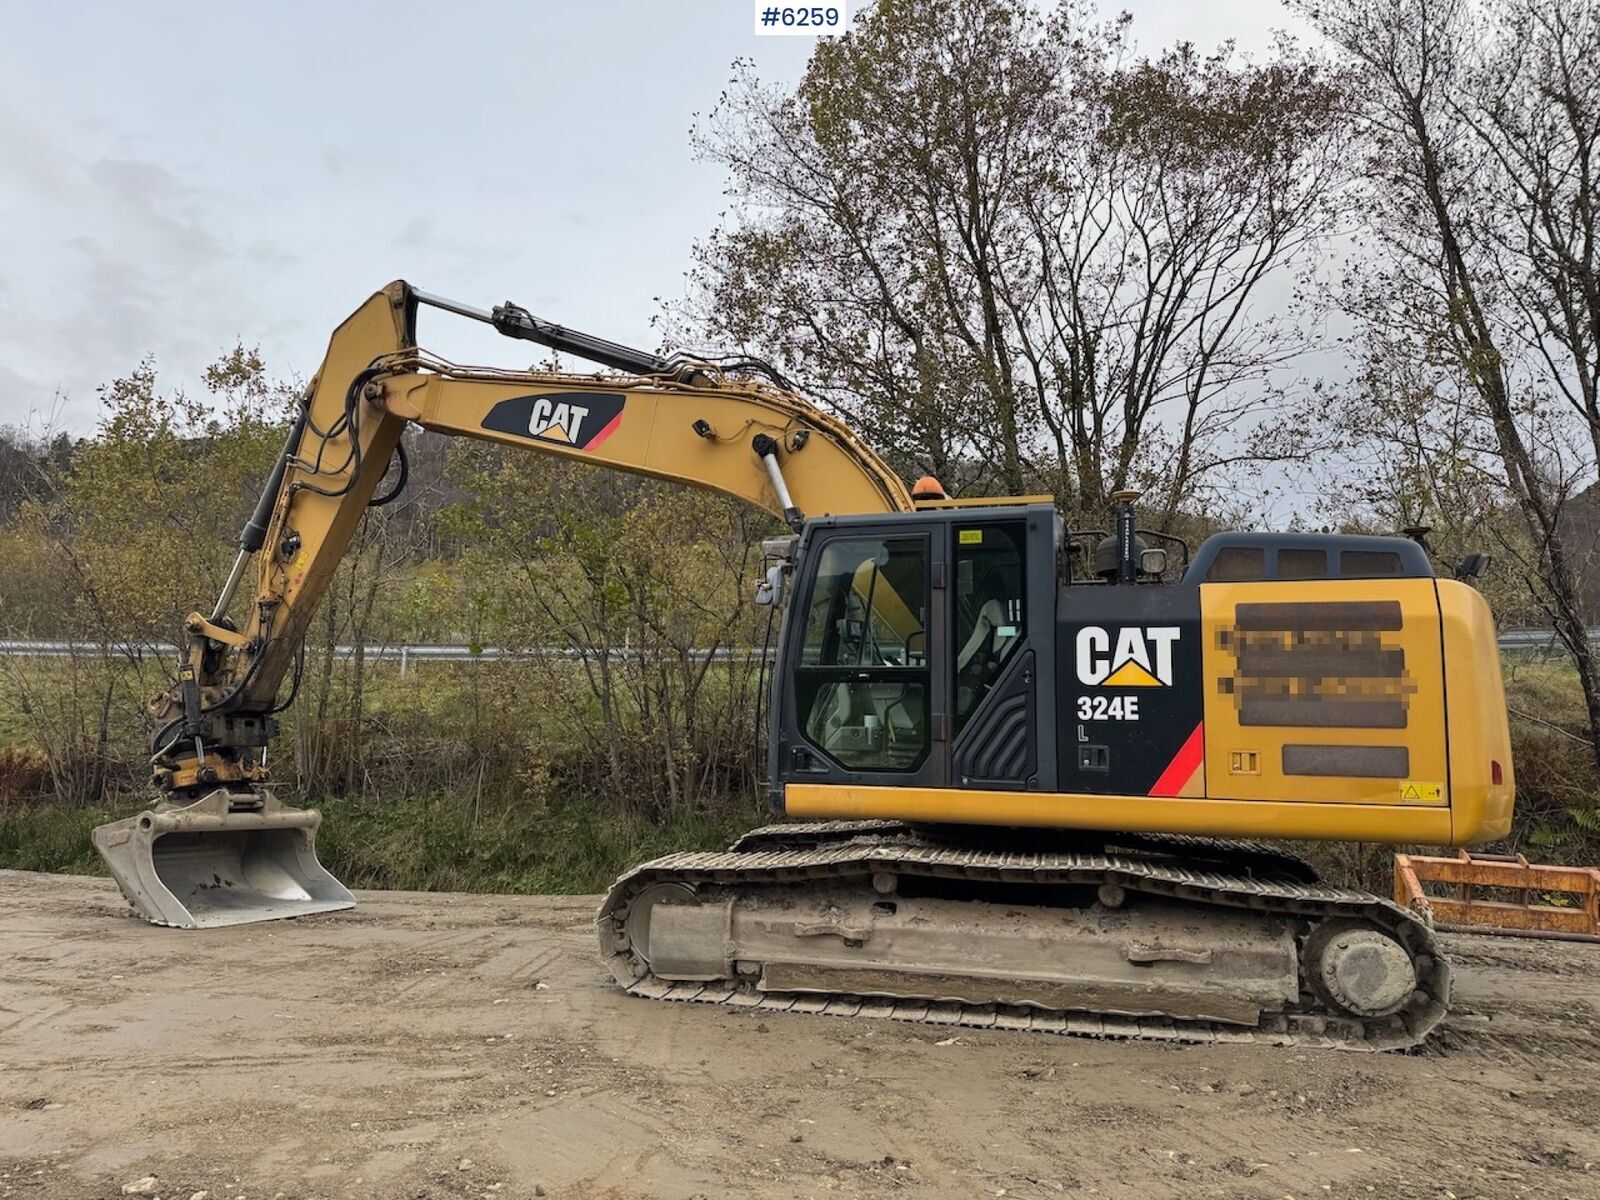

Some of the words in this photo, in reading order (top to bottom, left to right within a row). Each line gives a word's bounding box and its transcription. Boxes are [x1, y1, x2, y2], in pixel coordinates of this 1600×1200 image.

[528, 399, 590, 444] CAT
[1076, 626, 1181, 687] CAT
[1077, 696, 1140, 721] 324E
[1077, 724, 1089, 742] L
